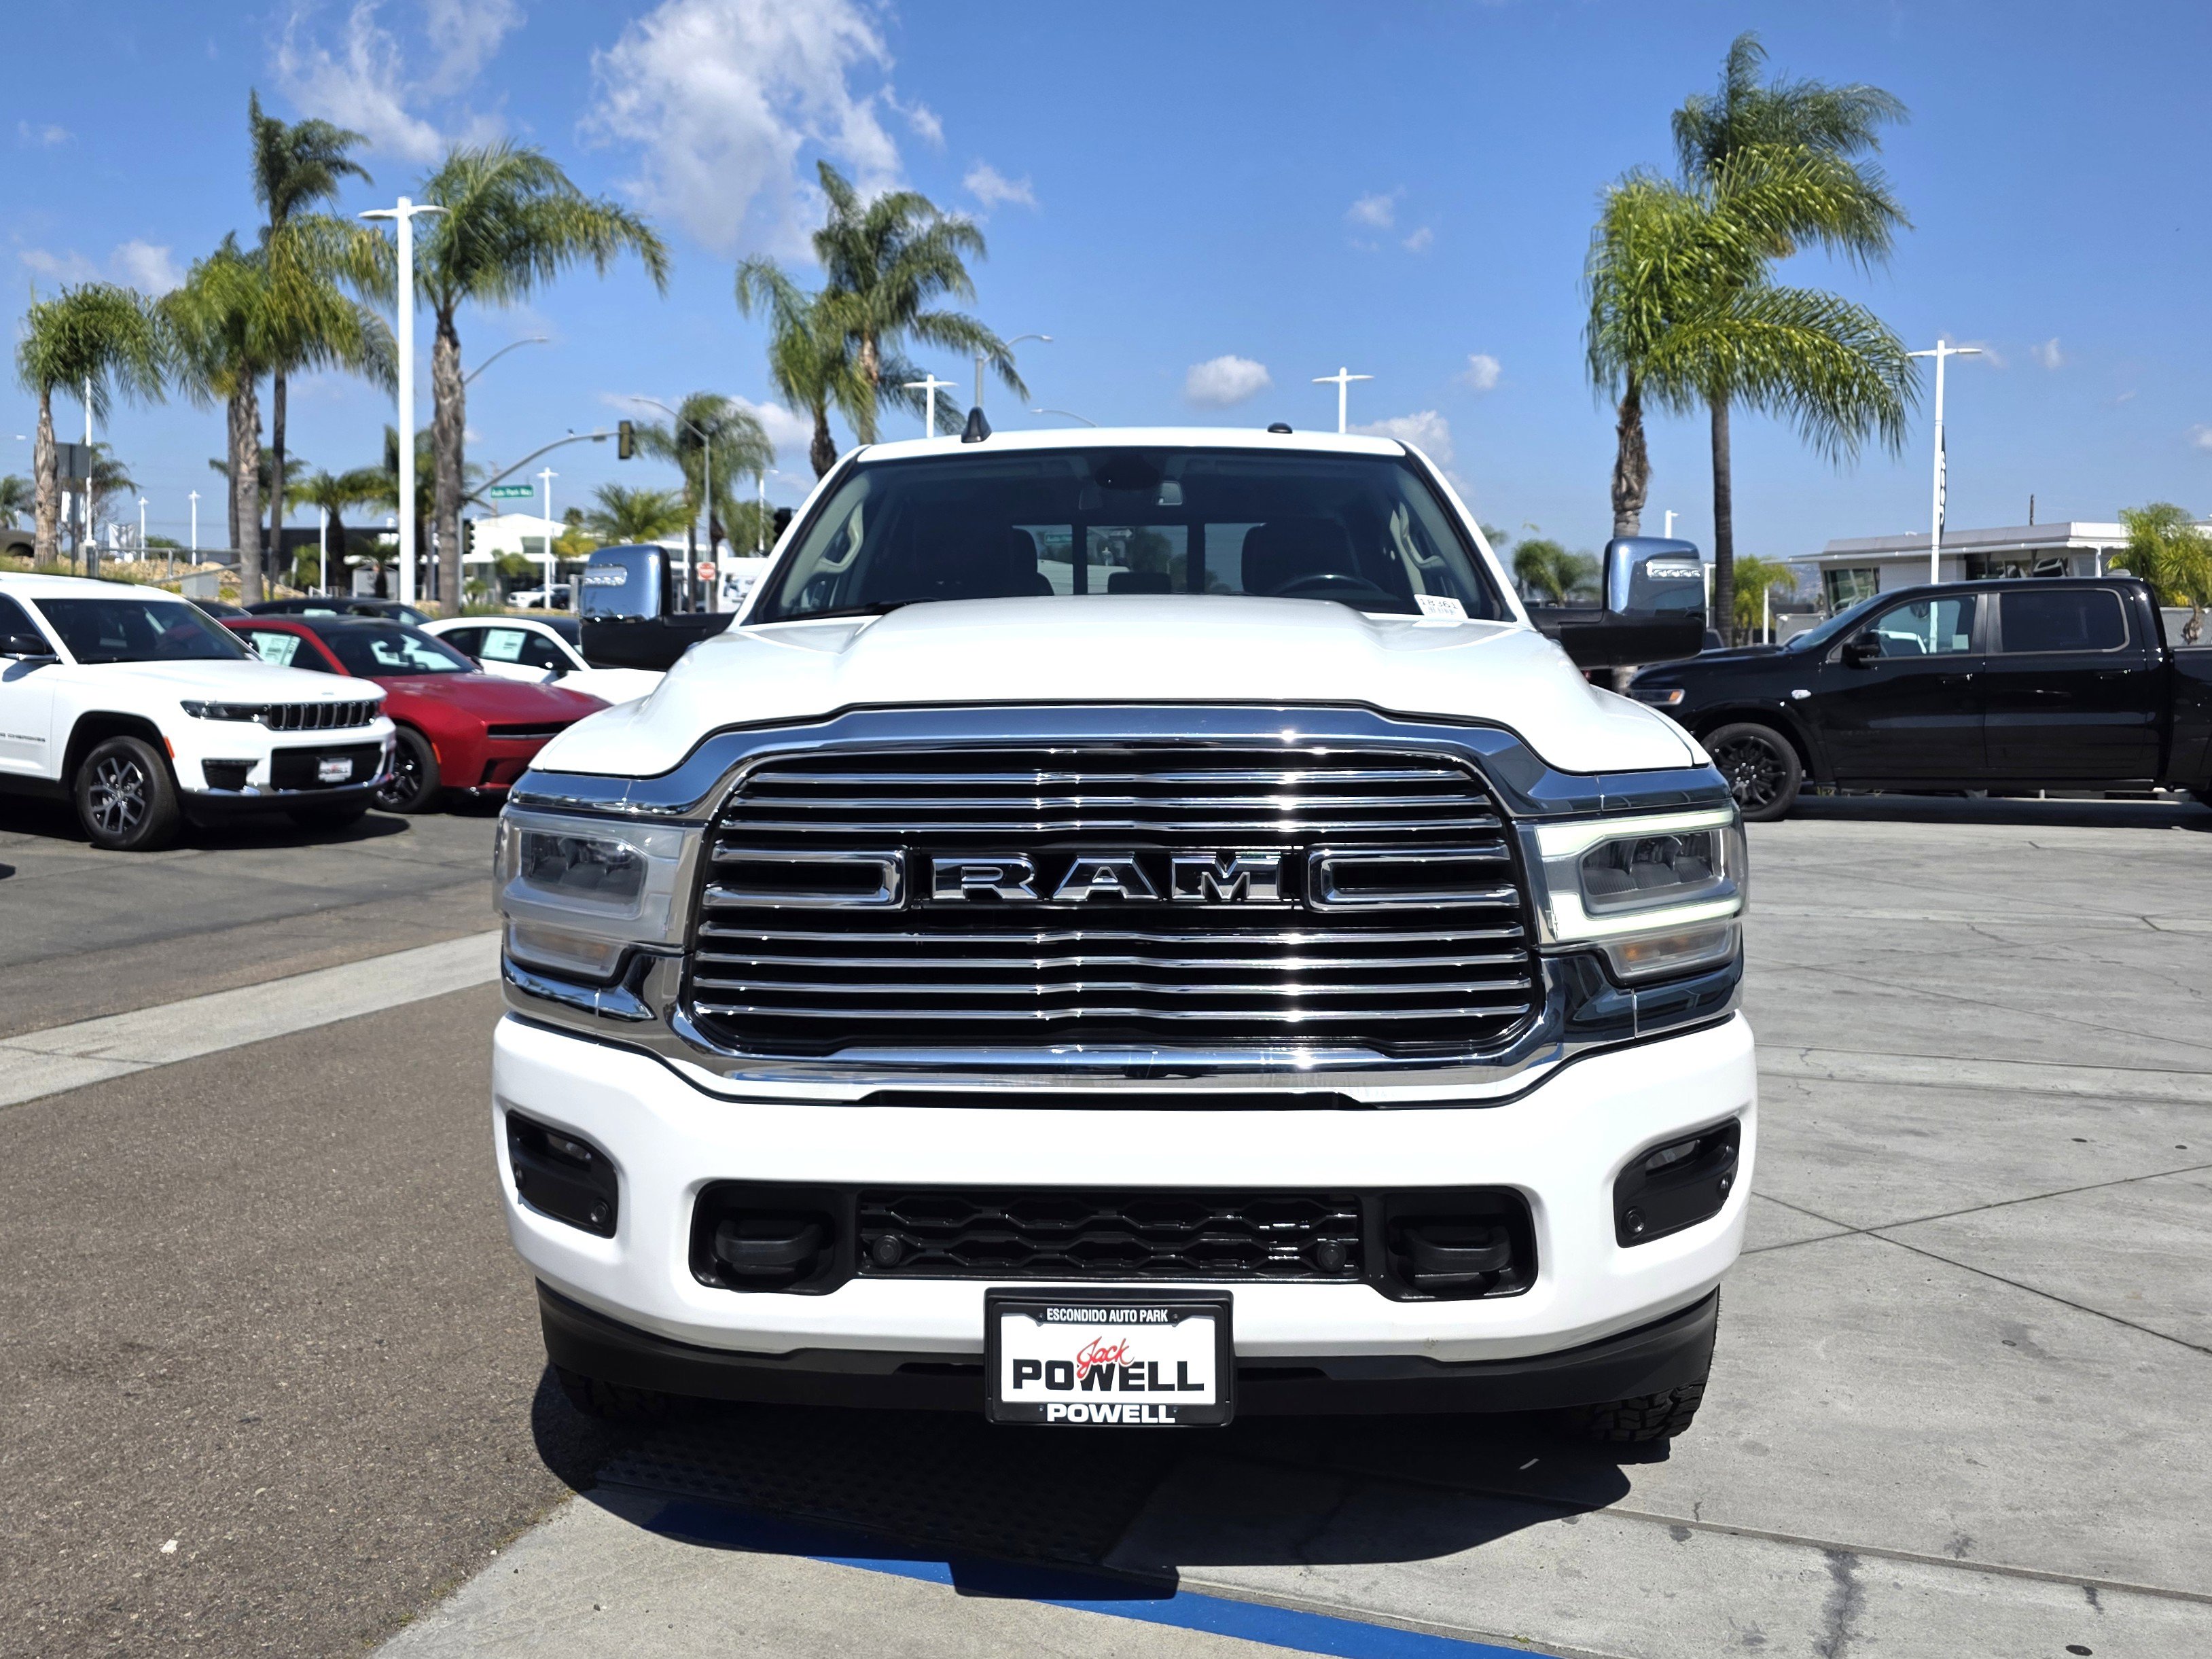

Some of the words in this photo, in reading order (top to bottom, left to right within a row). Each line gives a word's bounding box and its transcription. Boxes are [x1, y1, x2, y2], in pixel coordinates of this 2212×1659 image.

[931, 852, 1281, 900] RAM
[1047, 1308, 1107, 1322] ESCONDIDO
[1109, 1309, 1137, 1322] AUTO
[1140, 1310, 1168, 1322] PARK
[1077, 1336, 1135, 1380] Jack
[1013, 1359, 1204, 1391] POWELL
[1047, 1404, 1175, 1423] POWELL
